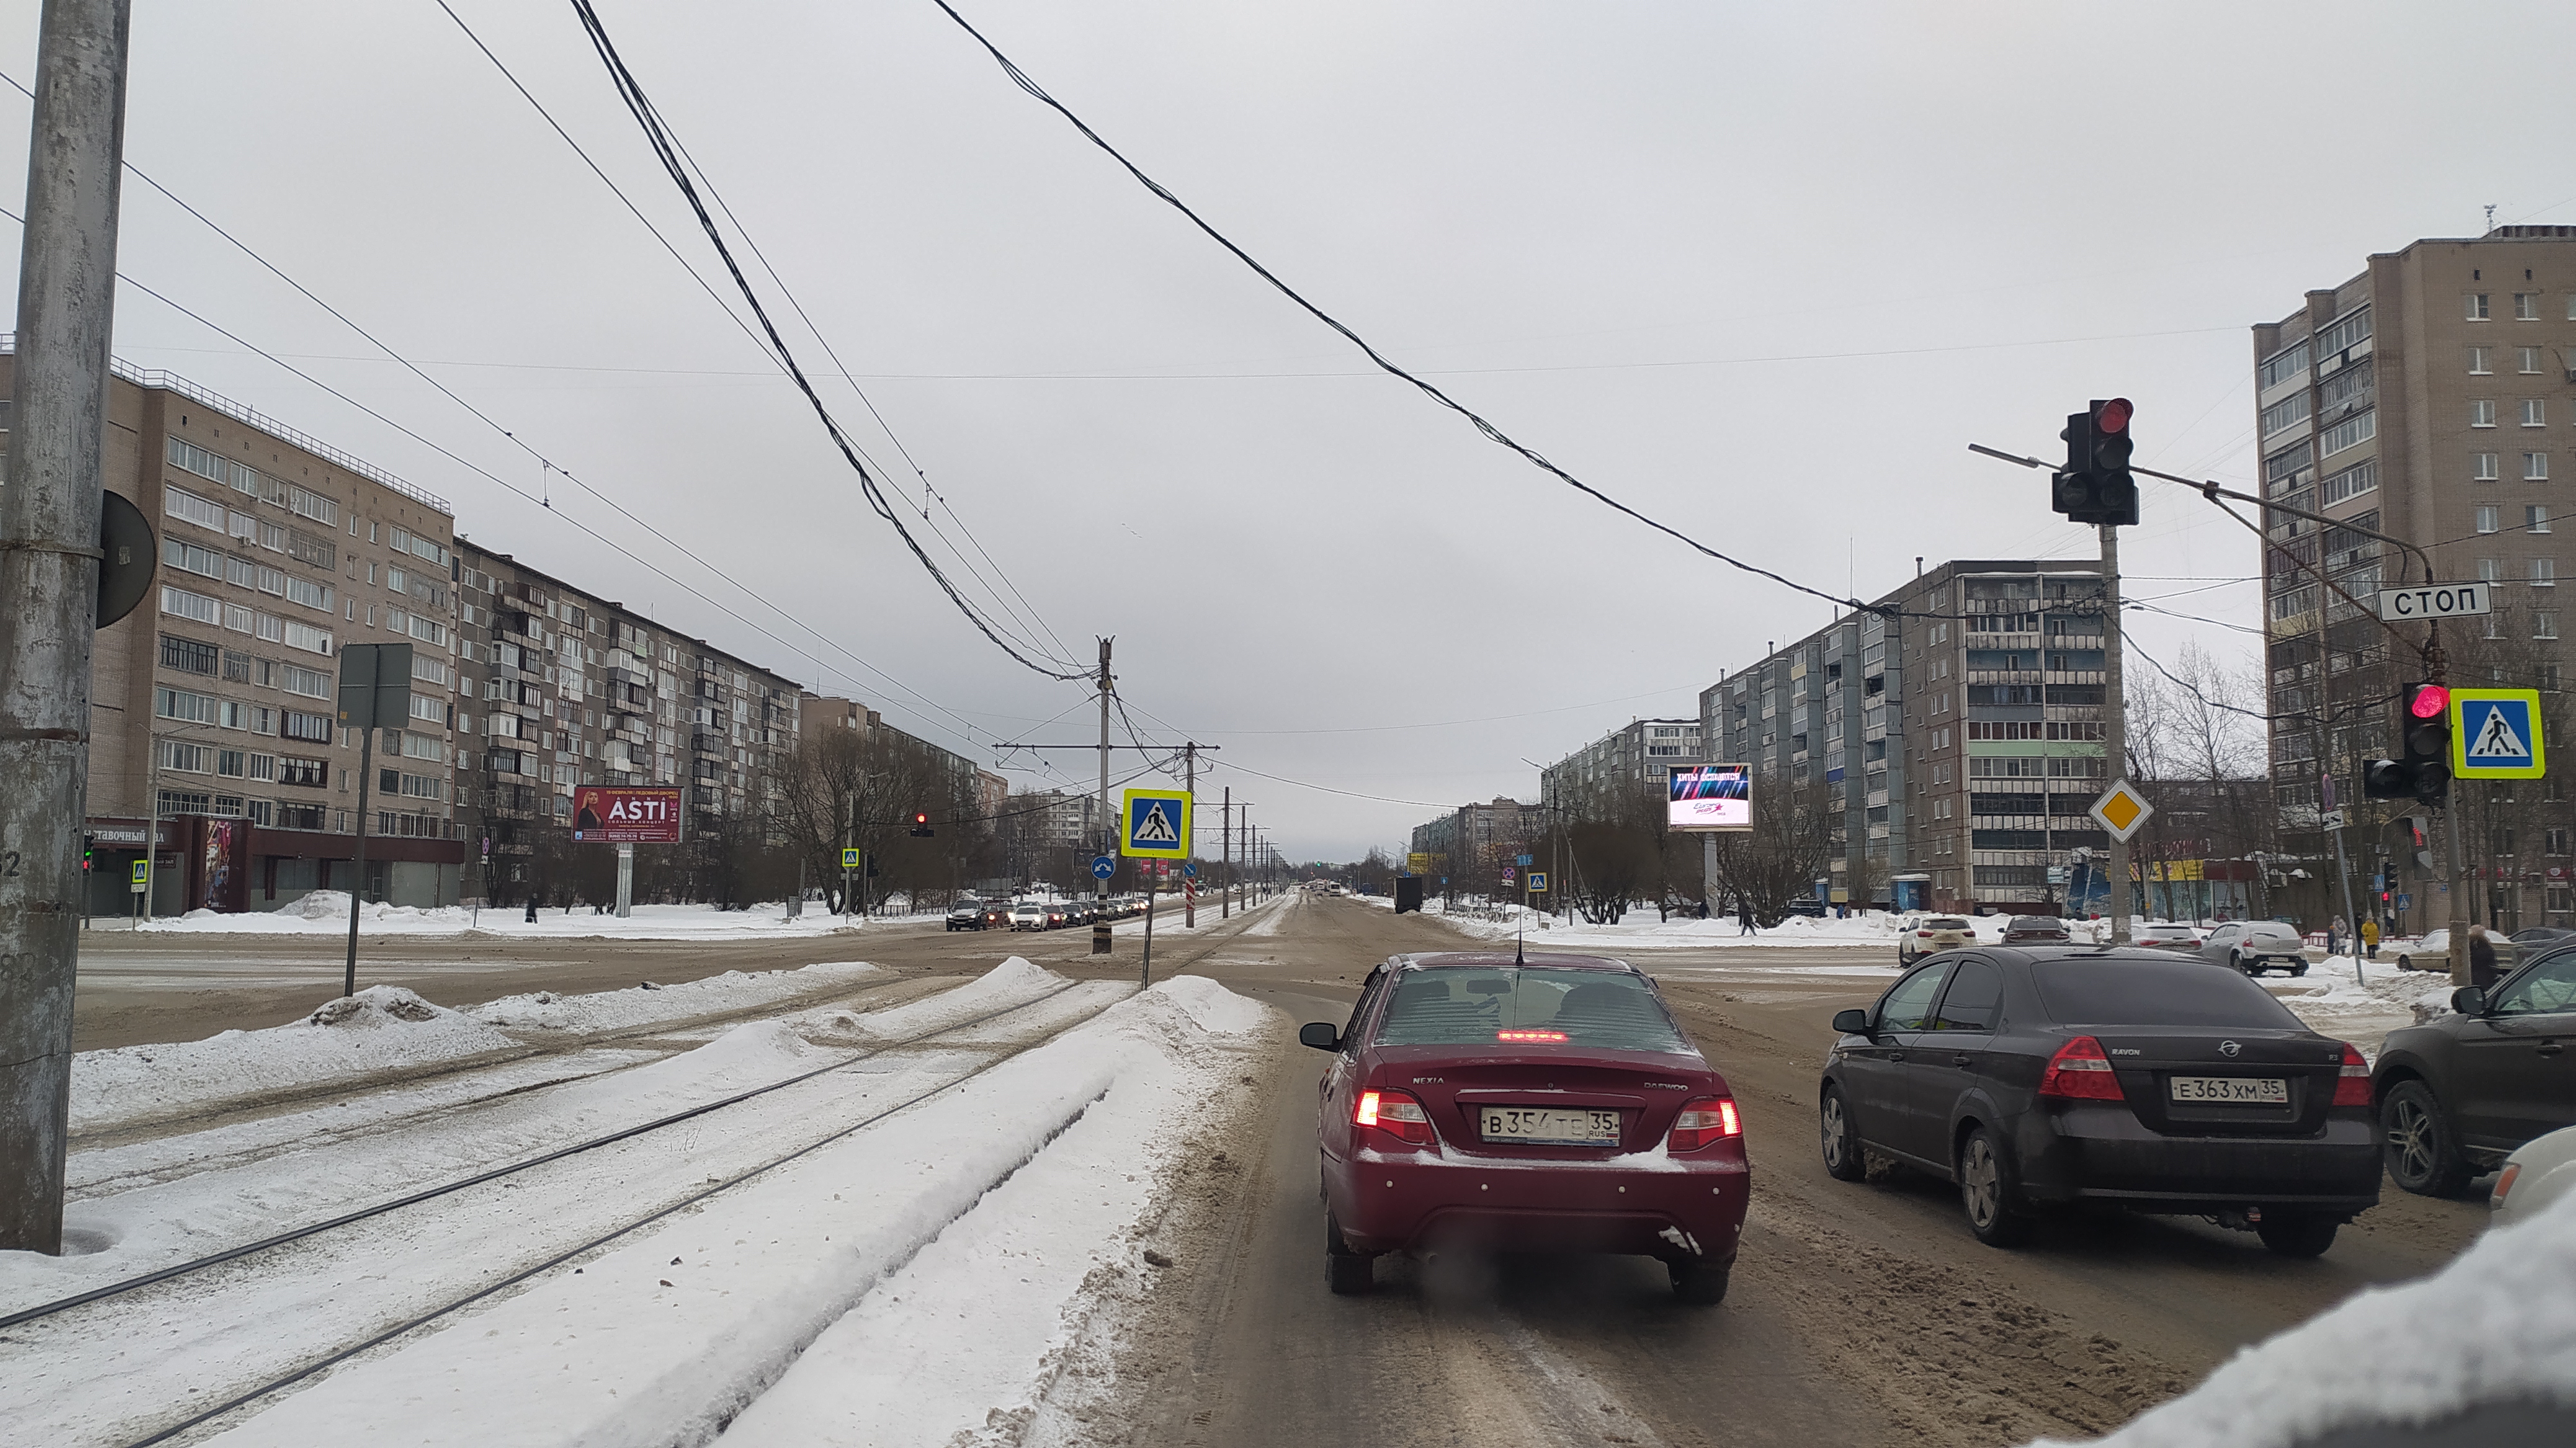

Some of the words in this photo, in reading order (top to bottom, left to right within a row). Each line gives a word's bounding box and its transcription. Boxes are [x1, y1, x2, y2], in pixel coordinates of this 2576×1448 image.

[2395, 588, 2476, 615] СТОП
[1676, 773, 1698, 781] ХИТЫ
[609, 801, 666, 820] ASTI
[155, 832, 164, 843] ал
[0, 851, 21, 877] 2
[1643, 1082, 1689, 1091] DAEWOO
[2261, 1080, 2279, 1094] 35
[1590, 1113, 1613, 1130] 35
